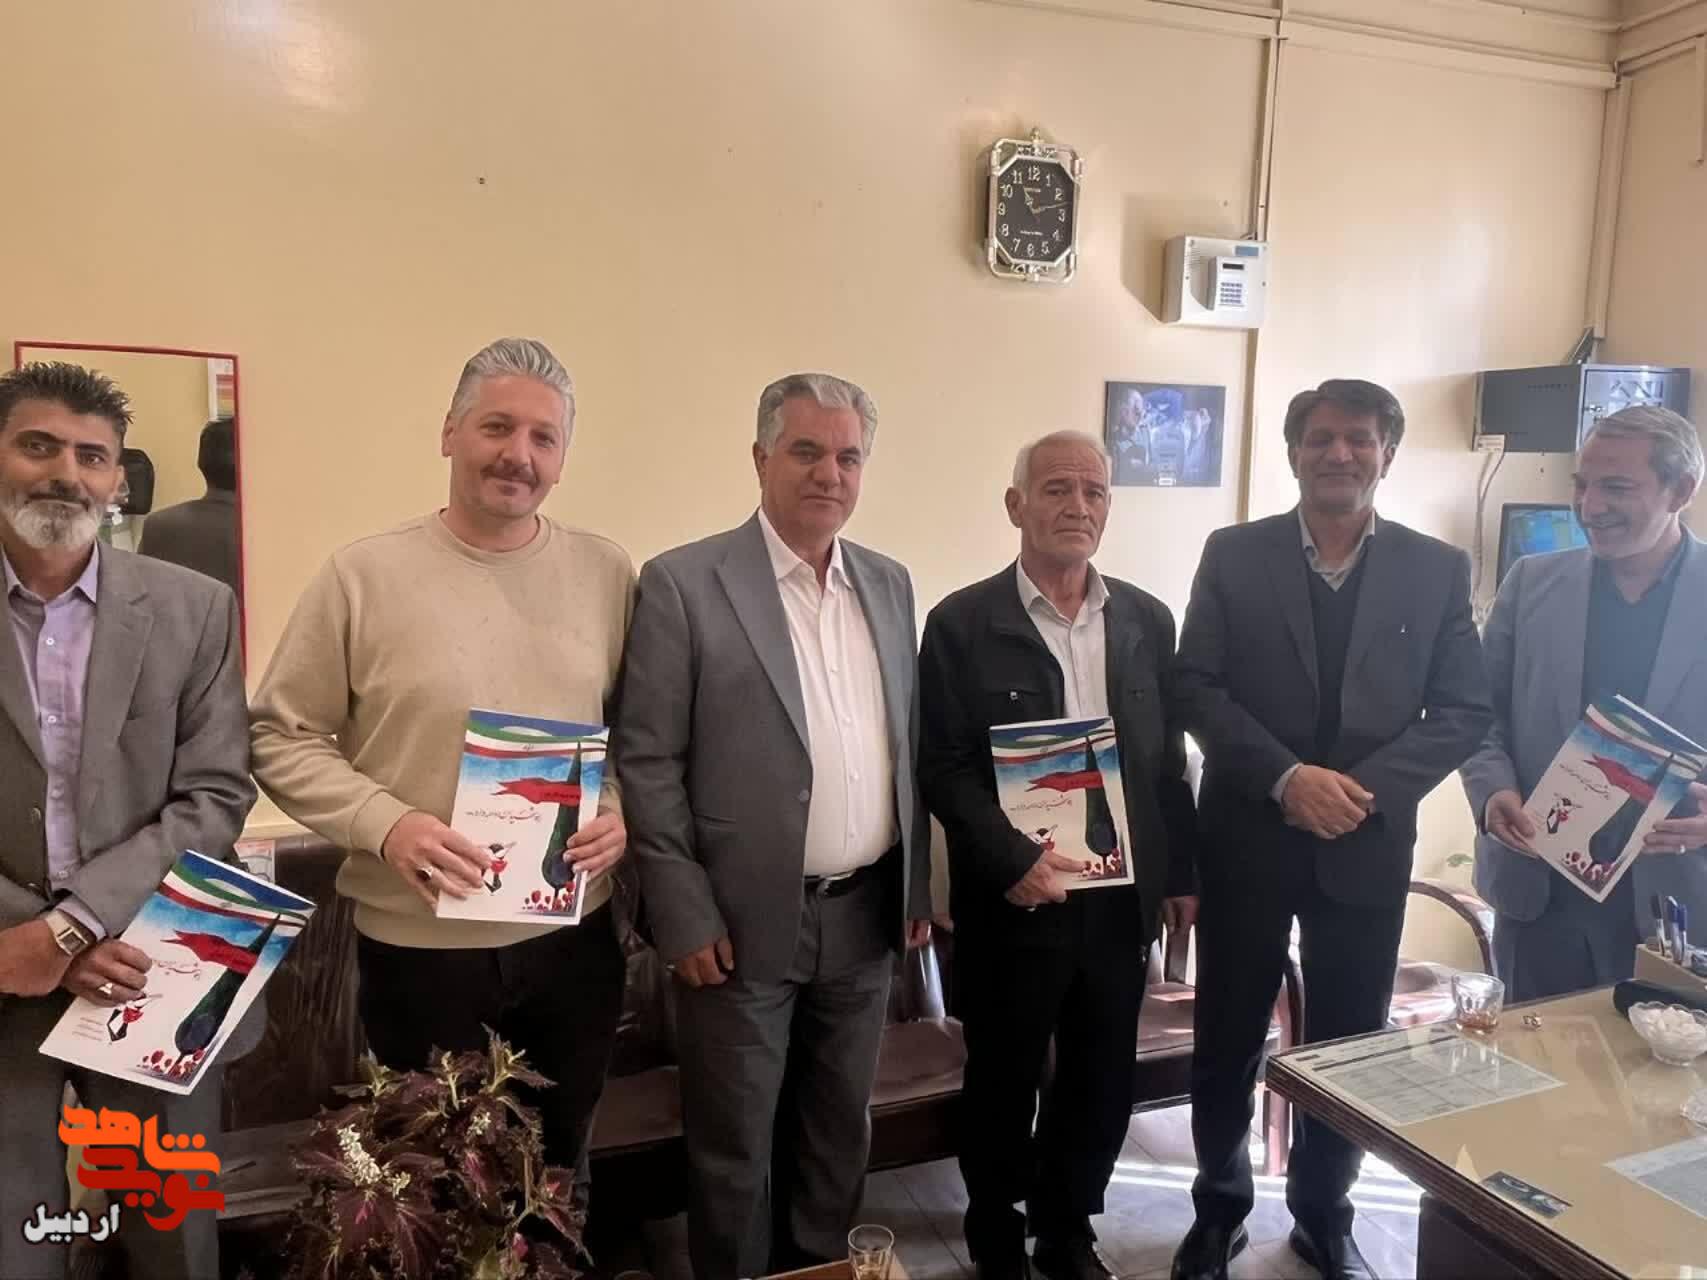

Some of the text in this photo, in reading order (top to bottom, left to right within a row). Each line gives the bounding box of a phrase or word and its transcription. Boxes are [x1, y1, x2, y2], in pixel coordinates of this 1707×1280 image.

[1011, 170, 1023, 184] 11
[1028, 166, 1041, 181] 12
[1045, 173, 1051, 187] 1
[1000, 184, 1013, 198] 10
[1054, 188, 1063, 200] 2
[998, 202, 1006, 215] 9
[1058, 209, 1066, 222] 3
[1001, 223, 1009, 236] 8
[1052, 229, 1061, 241] 4
[1012, 238, 1021, 252] 7
[1026, 243, 1035, 257] 6
[1041, 241, 1050, 254] 5
